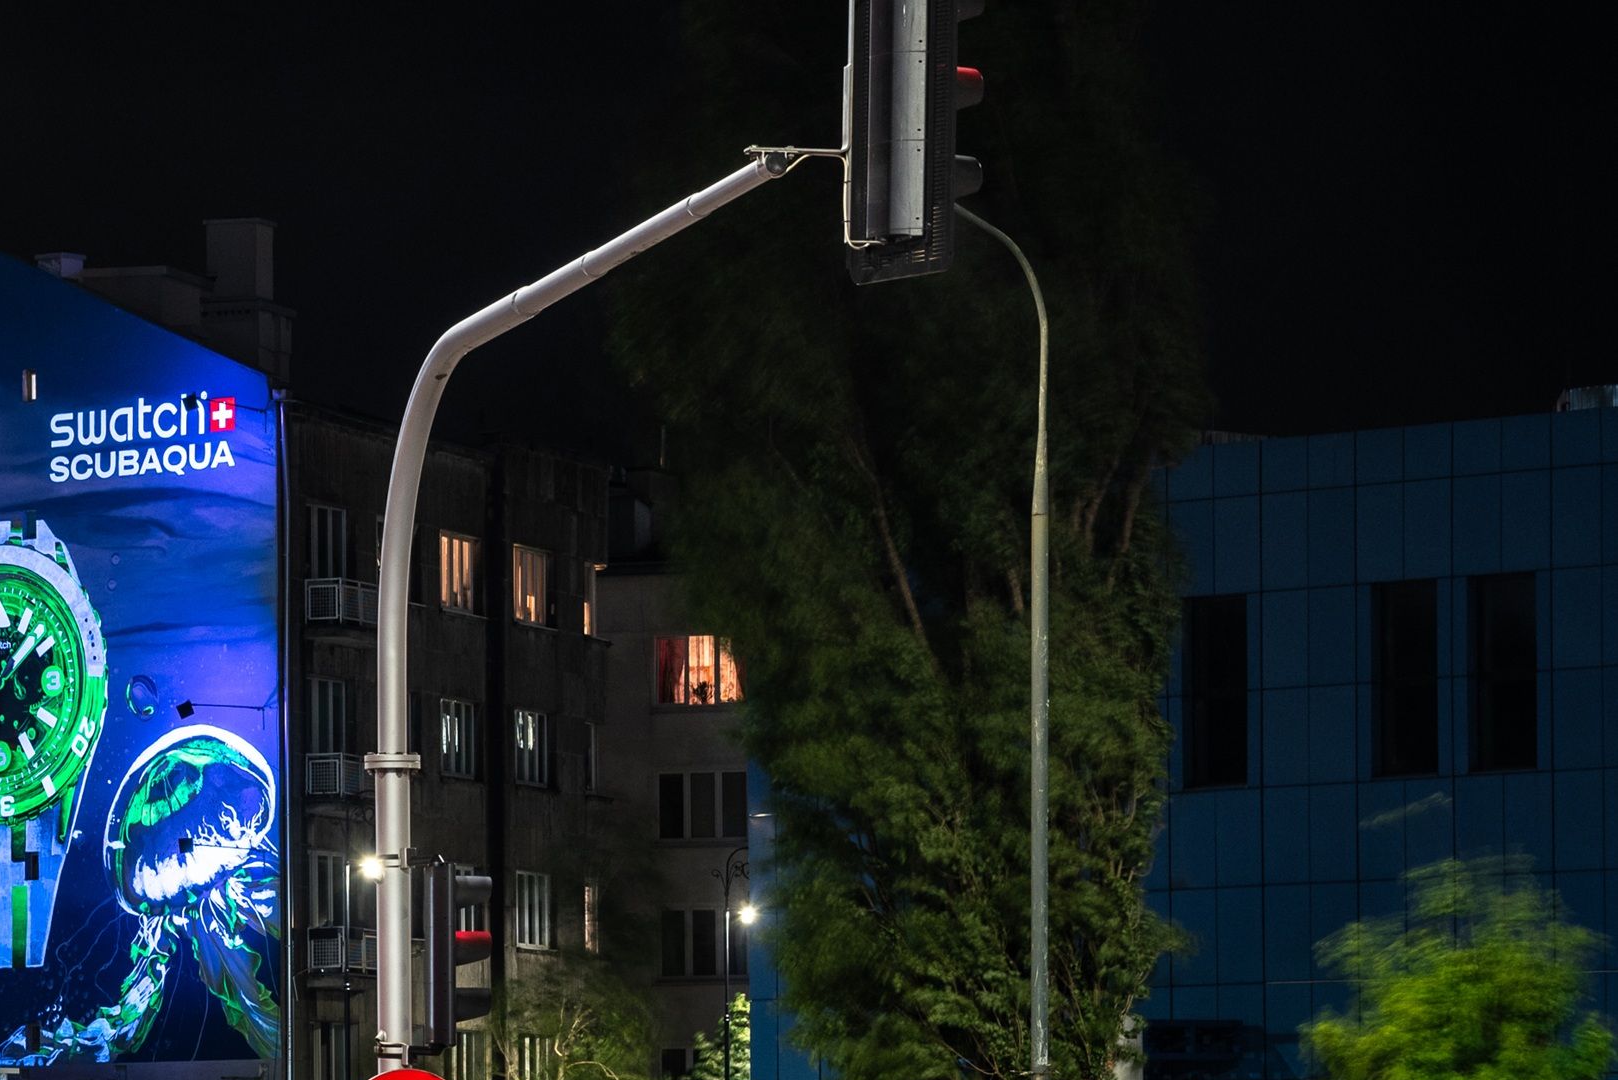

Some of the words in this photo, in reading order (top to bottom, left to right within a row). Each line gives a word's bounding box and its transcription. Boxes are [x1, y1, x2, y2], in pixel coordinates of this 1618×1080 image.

[49, 393, 205, 448] swatch
[49, 440, 236, 483] SCUBAQUA
[45, 670, 61, 696] 3
[71, 716, 96, 758] 20
